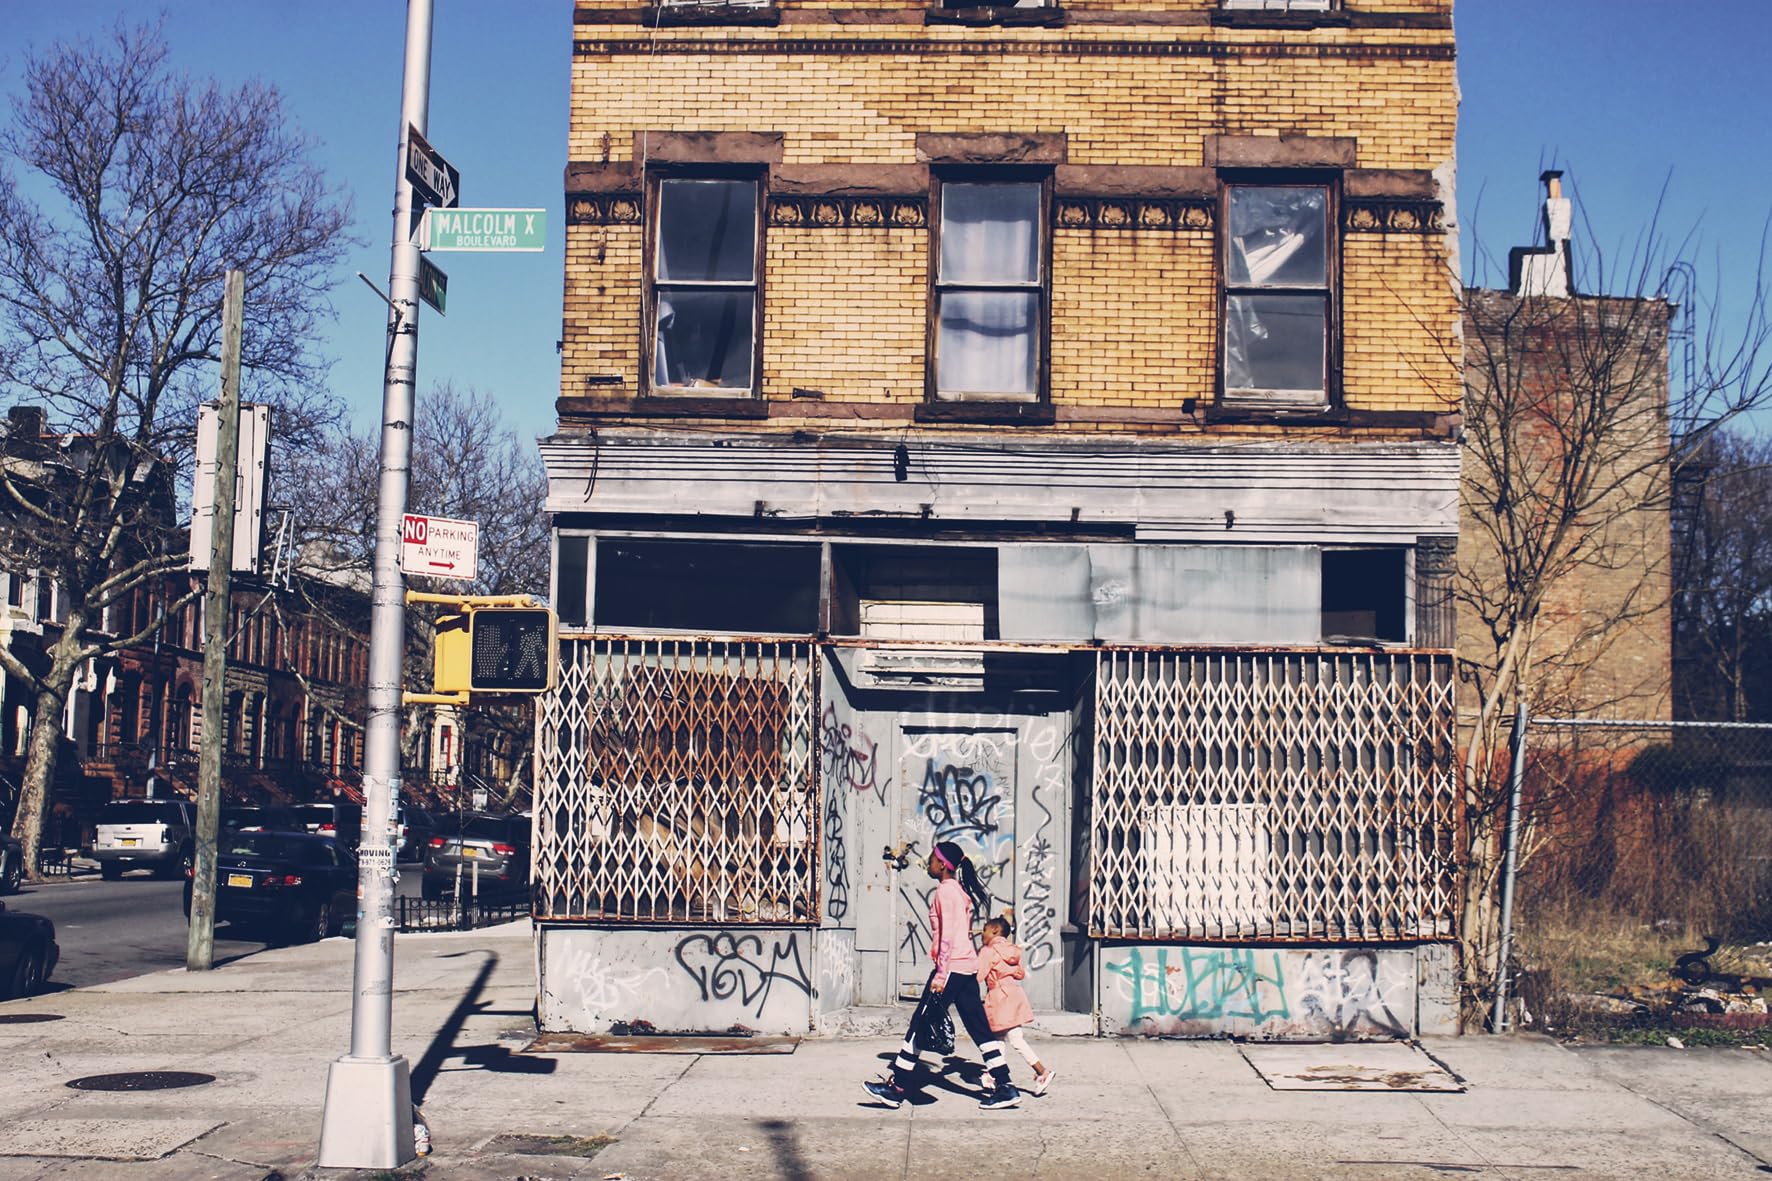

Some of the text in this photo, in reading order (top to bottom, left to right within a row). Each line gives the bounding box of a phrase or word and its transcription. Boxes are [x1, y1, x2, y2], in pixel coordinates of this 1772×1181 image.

[413, 148, 451, 200] ONE WAY
[439, 213, 535, 235] MALCOLM X
[456, 235, 517, 247] BOULEVARD
[405, 519, 474, 543] NO PARKING
[418, 546, 461, 560] ANYTIME
[359, 849, 391, 857] MOVING
